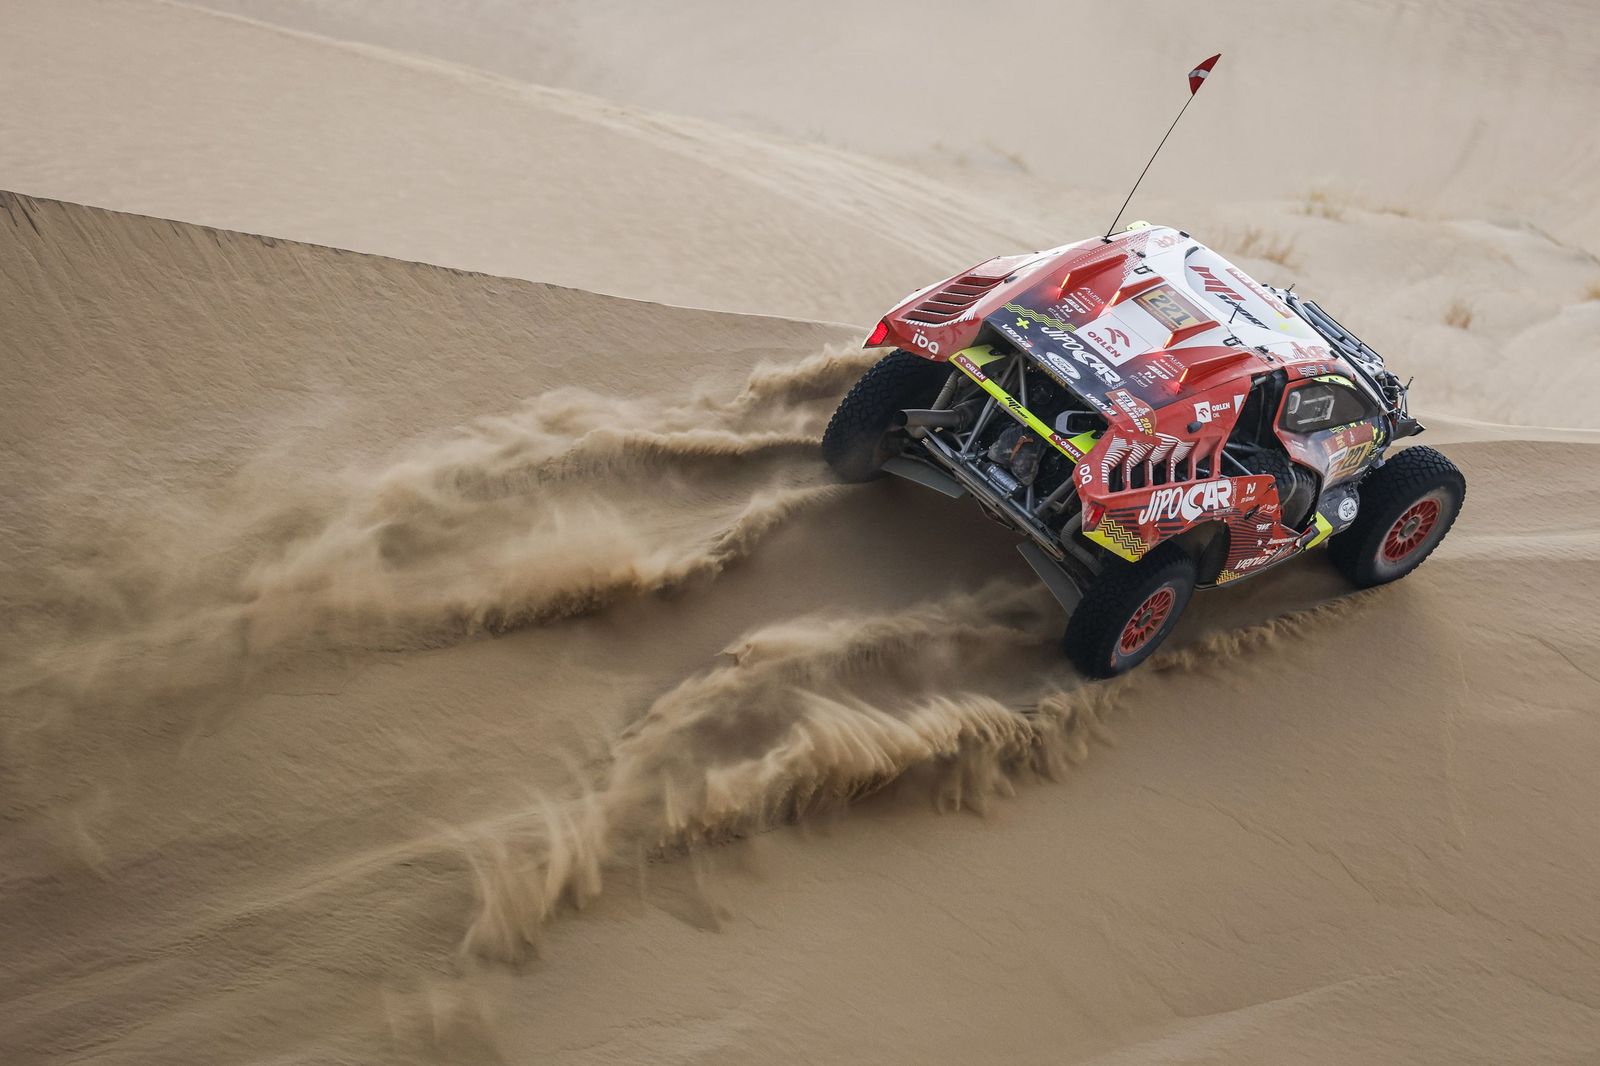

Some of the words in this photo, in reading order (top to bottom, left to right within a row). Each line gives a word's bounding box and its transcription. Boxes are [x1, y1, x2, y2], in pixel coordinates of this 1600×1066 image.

[1151, 295, 1190, 326] 221
[1001, 323, 1032, 349] verva
[1087, 331, 1121, 358] ORLEN
[1040, 326, 1122, 386] JIPOCAR
[965, 361, 986, 382] ORLEN
[1037, 354, 1075, 385] RACING
[1085, 393, 1117, 417] verva
[1211, 402, 1231, 412] ORLEN
[1140, 417, 1153, 436] 202
[1060, 440, 1081, 460] ORLEN
[1138, 479, 1232, 526] JIPOCAR
